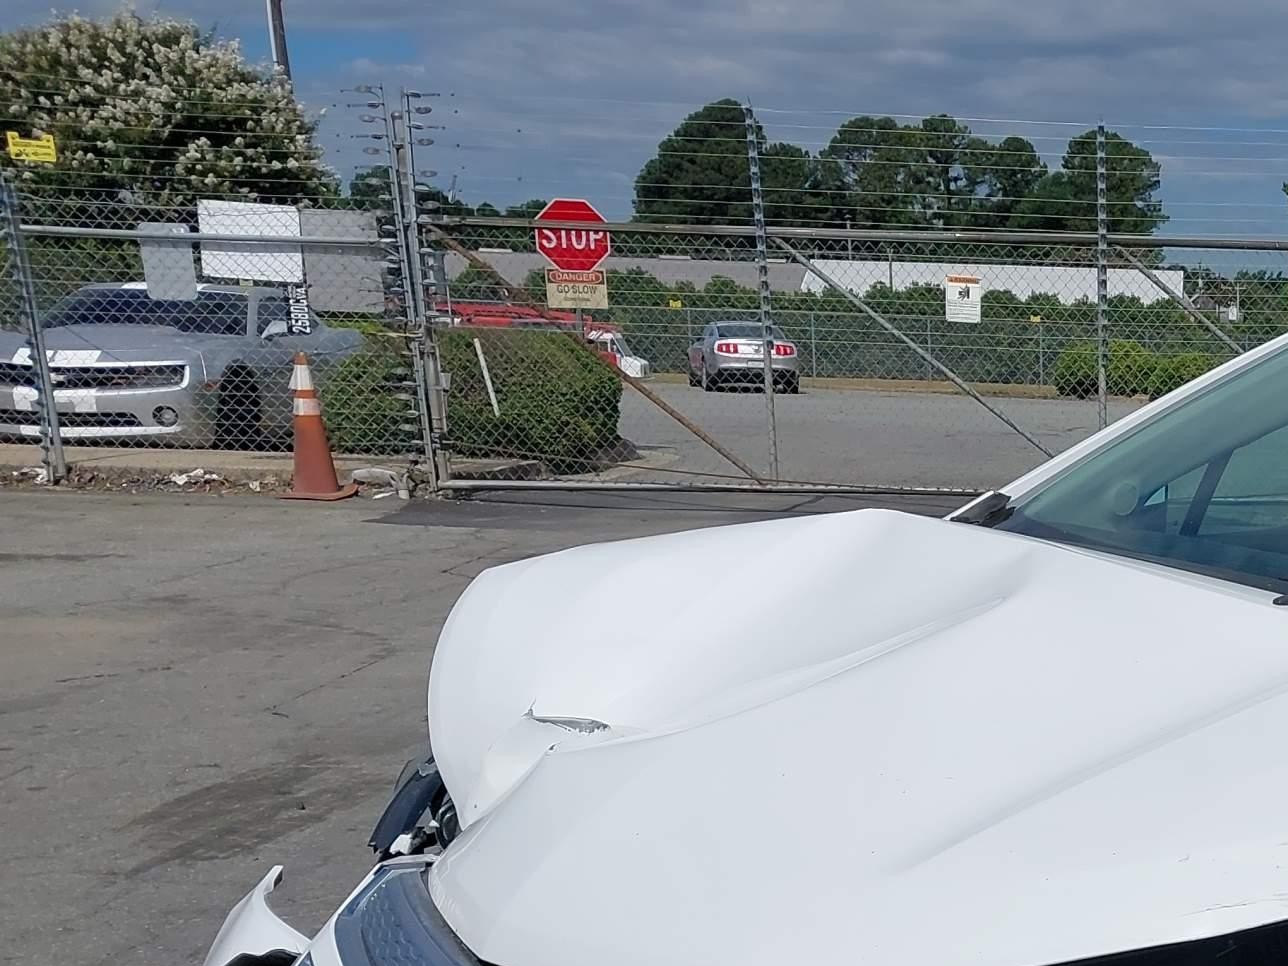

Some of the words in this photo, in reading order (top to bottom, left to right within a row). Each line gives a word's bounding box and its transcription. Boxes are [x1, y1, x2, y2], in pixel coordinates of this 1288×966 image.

[541, 228, 604, 250] STOP
[555, 272, 596, 282] DANGER
[556, 284, 570, 294] GO
[571, 285, 598, 295] SLOW
